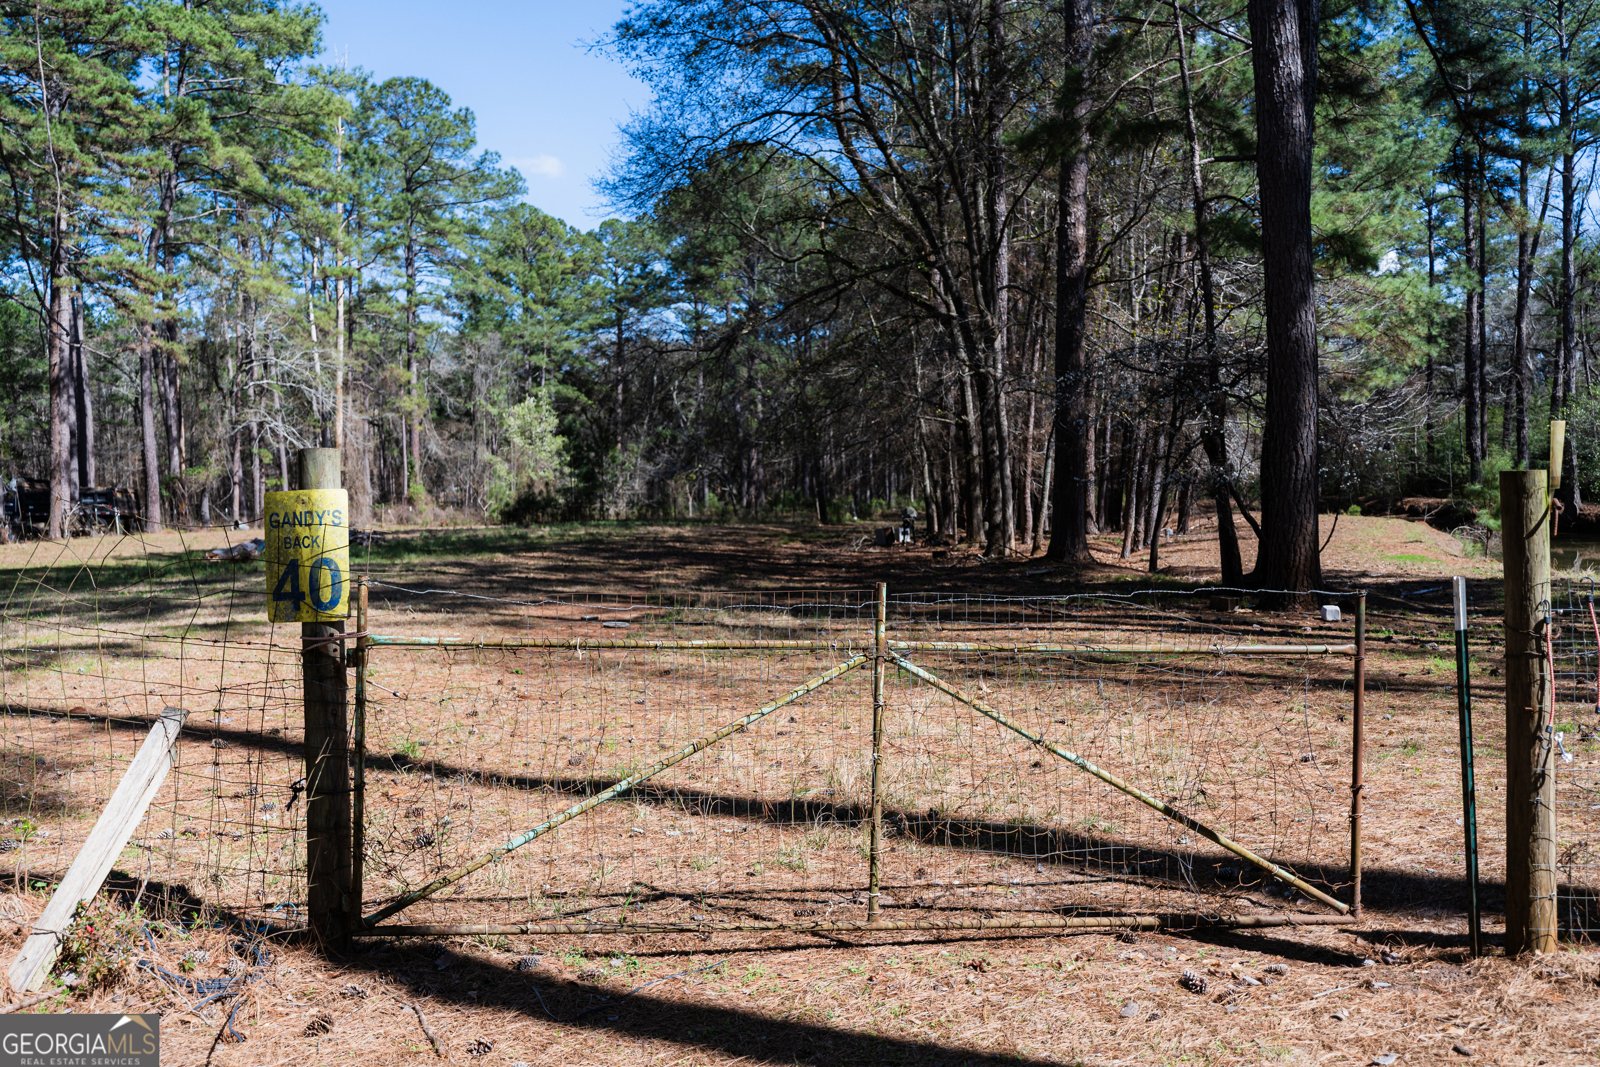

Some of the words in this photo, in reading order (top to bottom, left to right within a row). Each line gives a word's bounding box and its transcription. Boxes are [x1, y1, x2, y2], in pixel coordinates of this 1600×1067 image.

[269, 509, 343, 529] GANDY'S
[283, 535, 320, 549] BACK
[272, 557, 342, 612] 40
